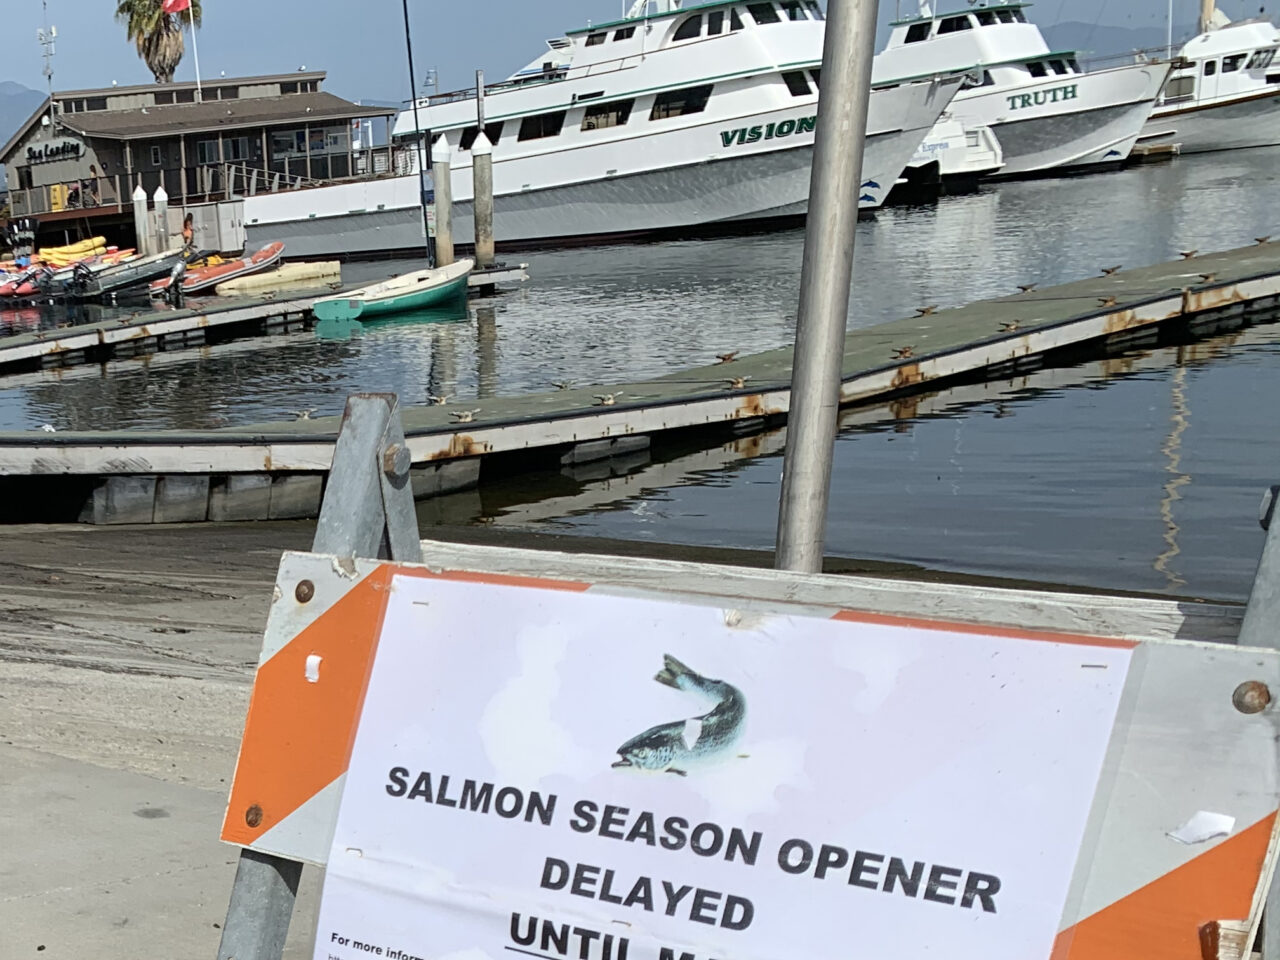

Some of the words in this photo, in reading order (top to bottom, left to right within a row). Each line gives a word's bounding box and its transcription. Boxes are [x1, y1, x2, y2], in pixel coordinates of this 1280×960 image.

[1006, 84, 1078, 111] TRUTH
[720, 115, 817, 148] VISION
[44, 142, 80, 157] Landing
[385, 766, 558, 826] SALMON
[569, 799, 764, 866] SEASON
[776, 838, 1003, 914] OPENER
[540, 856, 757, 932] DELAYED
[330, 932, 350, 947] For
[353, 940, 383, 956] more
